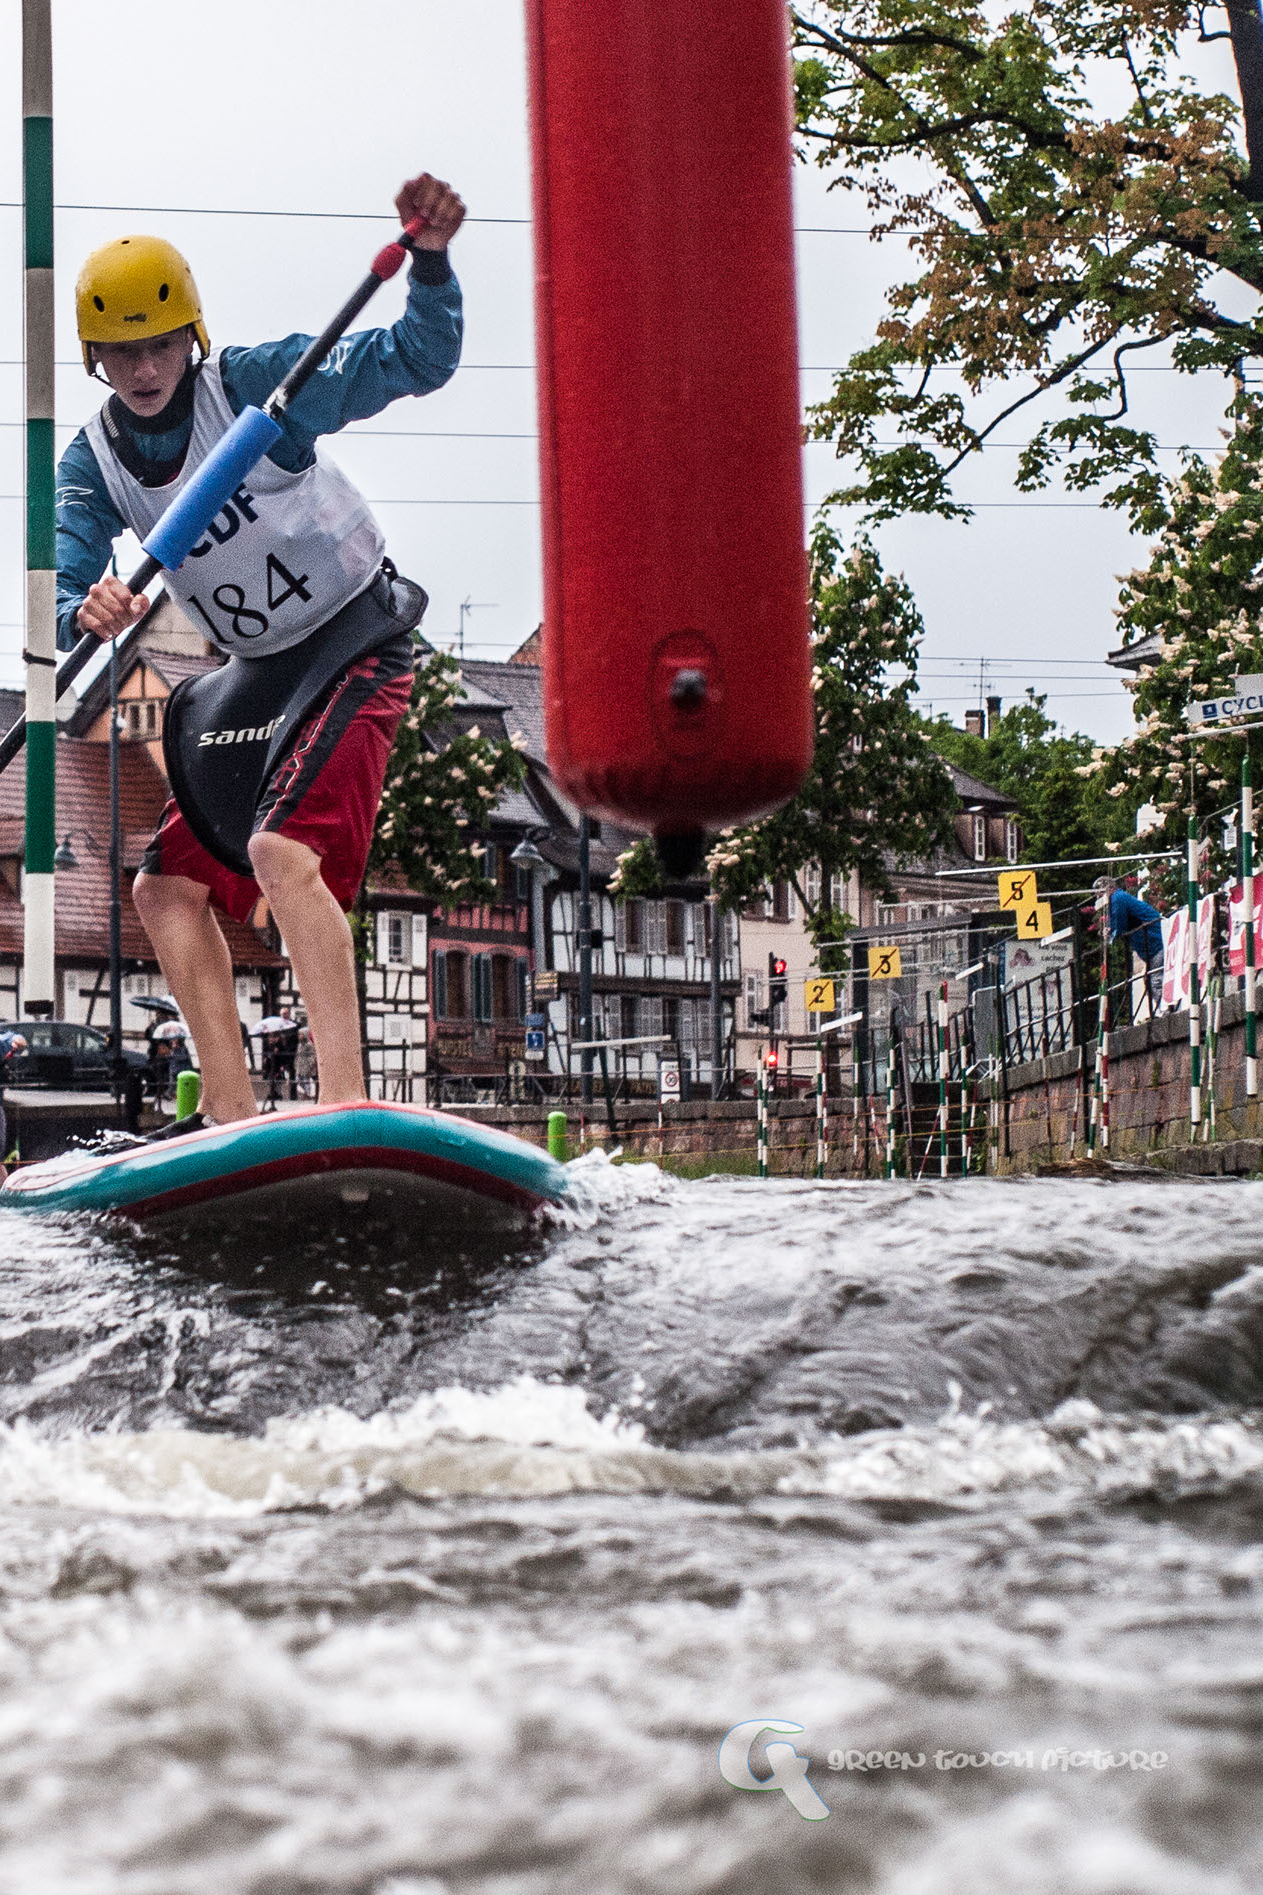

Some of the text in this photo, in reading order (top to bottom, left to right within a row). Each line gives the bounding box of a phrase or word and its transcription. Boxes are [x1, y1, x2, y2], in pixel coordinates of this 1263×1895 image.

[187, 552, 313, 644] 184
[1011, 881, 1024, 901] 5
[1025, 910, 1039, 932] 4
[879, 955, 892, 975] 3
[812, 985, 825, 1004] 2
